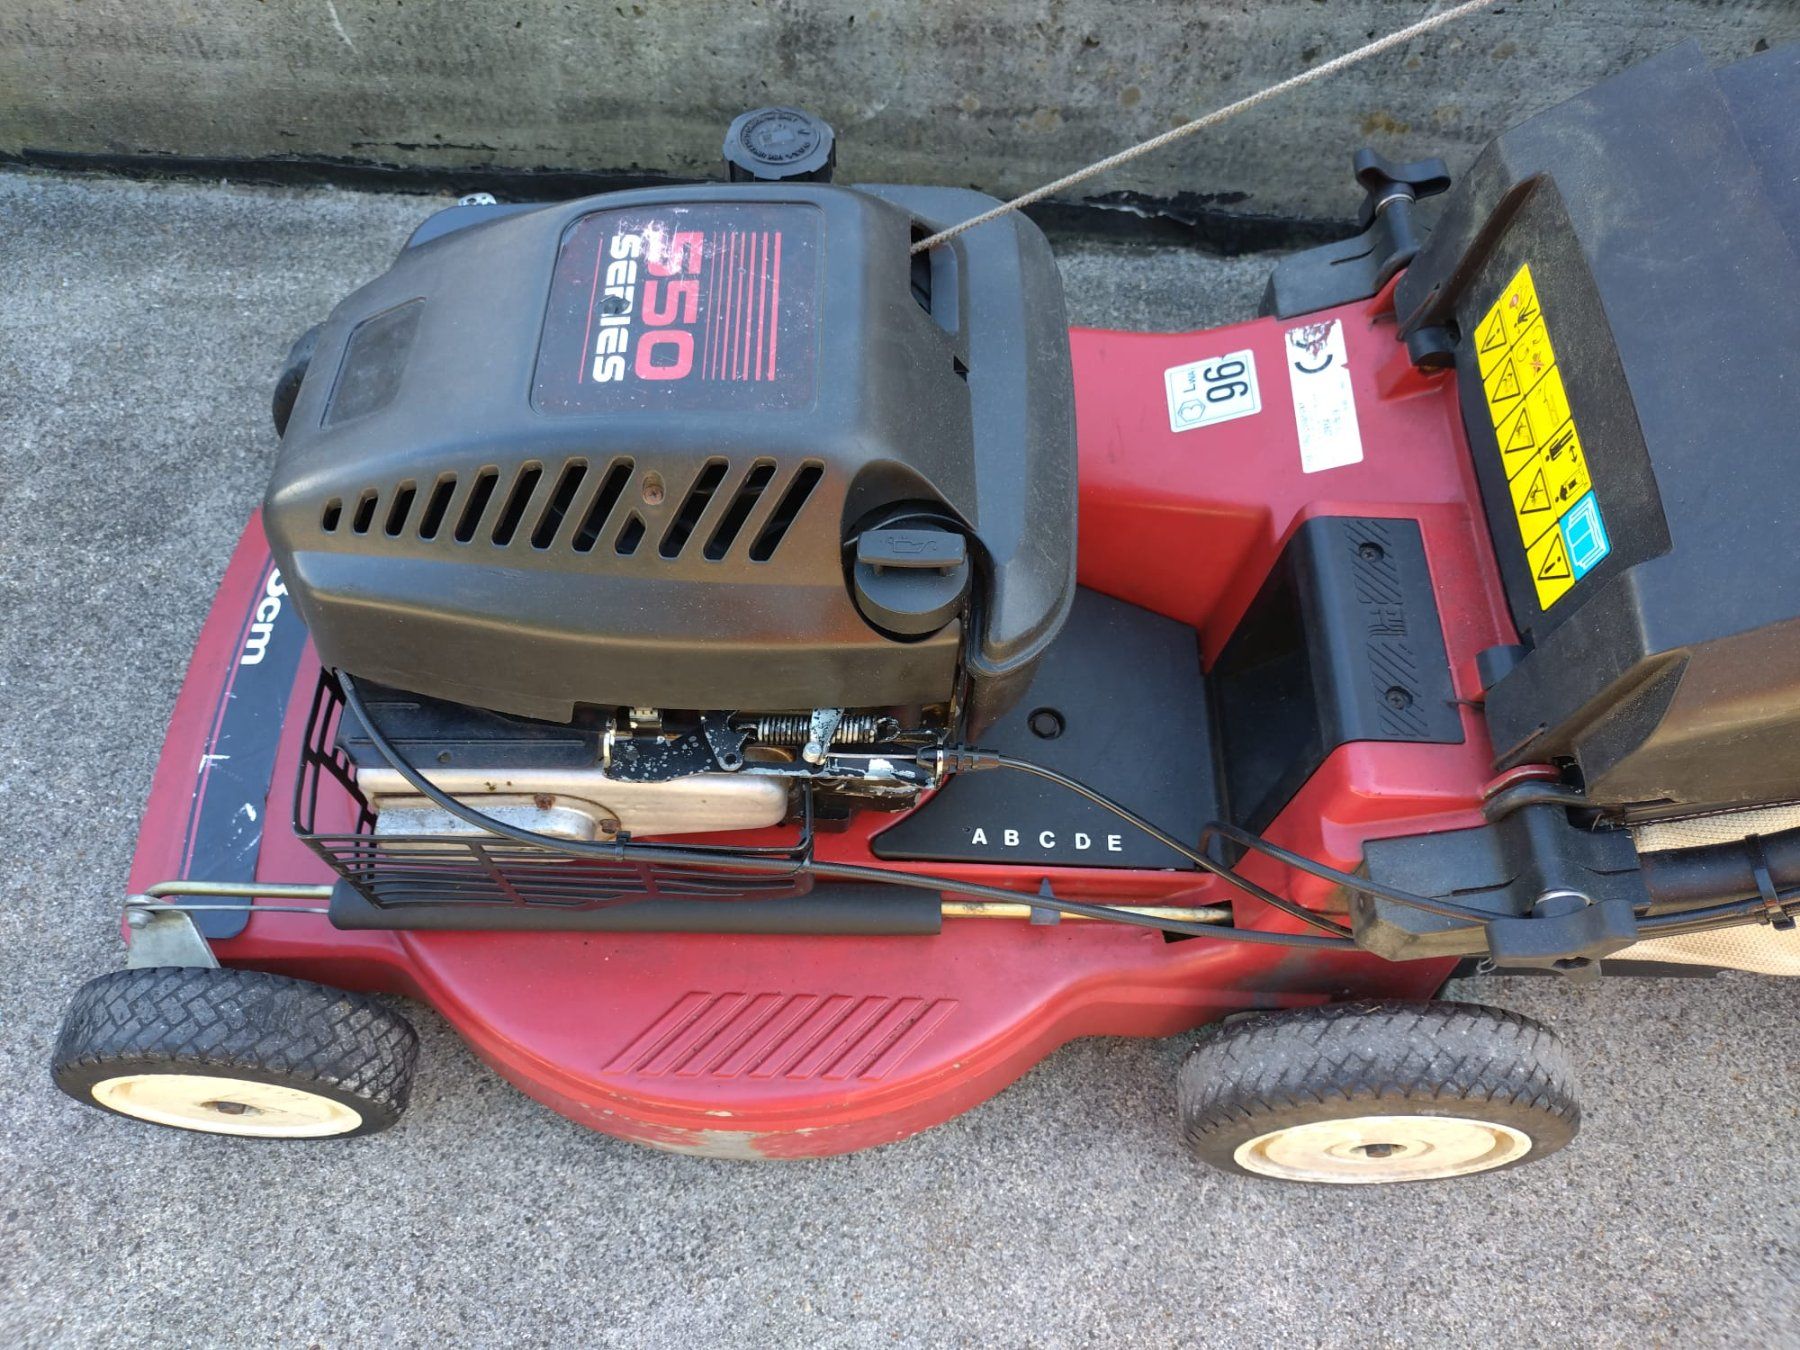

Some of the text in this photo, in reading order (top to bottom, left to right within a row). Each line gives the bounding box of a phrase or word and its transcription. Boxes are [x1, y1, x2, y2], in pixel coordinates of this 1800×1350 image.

[634, 231, 704, 380] 550
[1203, 360, 1249, 404] 96
[971, 827, 1122, 851] A B C D E
